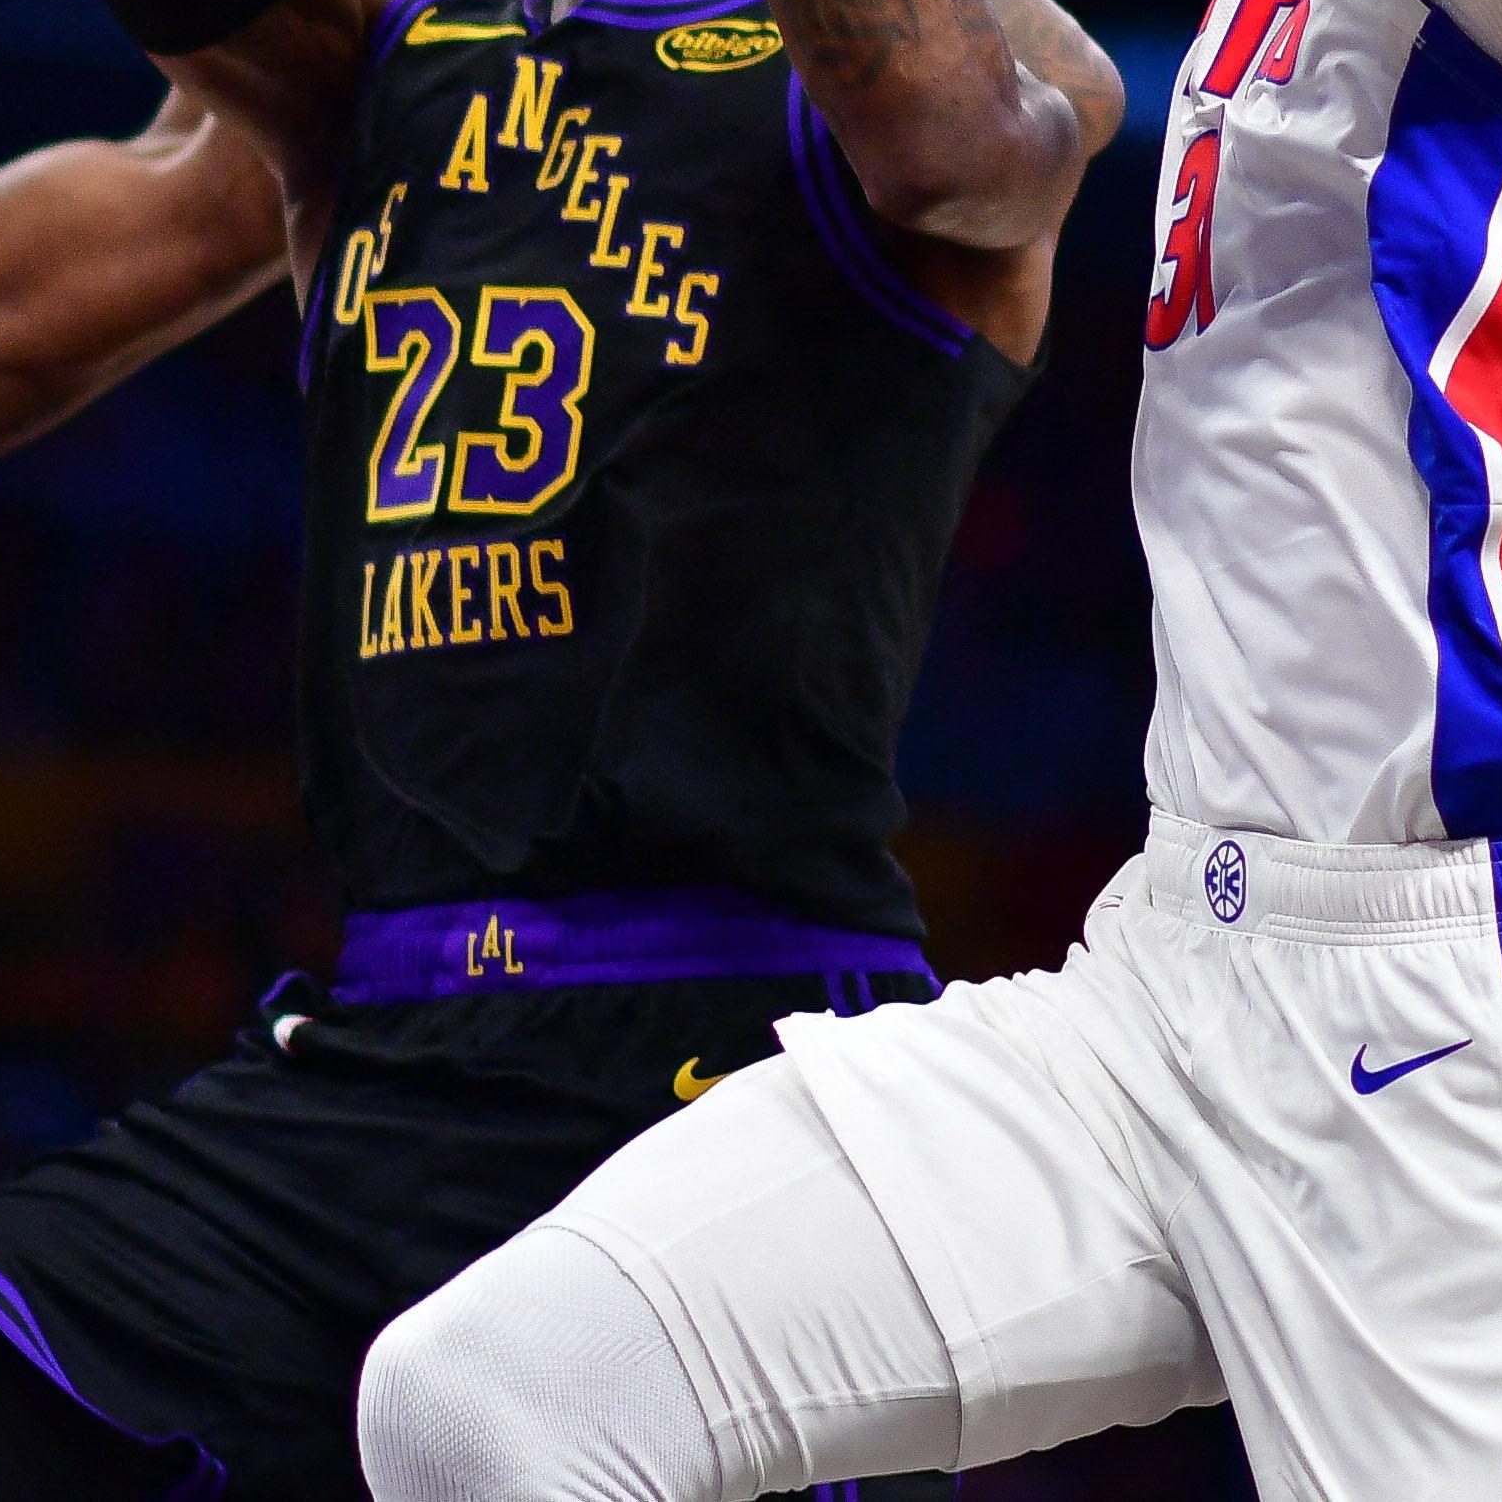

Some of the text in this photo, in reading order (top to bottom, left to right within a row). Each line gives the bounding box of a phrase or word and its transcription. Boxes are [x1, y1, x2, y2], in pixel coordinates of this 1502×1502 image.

[439, 55, 720, 366] ANGELES
[361, 284, 595, 524] 23
[360, 538, 574, 659] LAKERS
[467, 914, 524, 977] LAL
